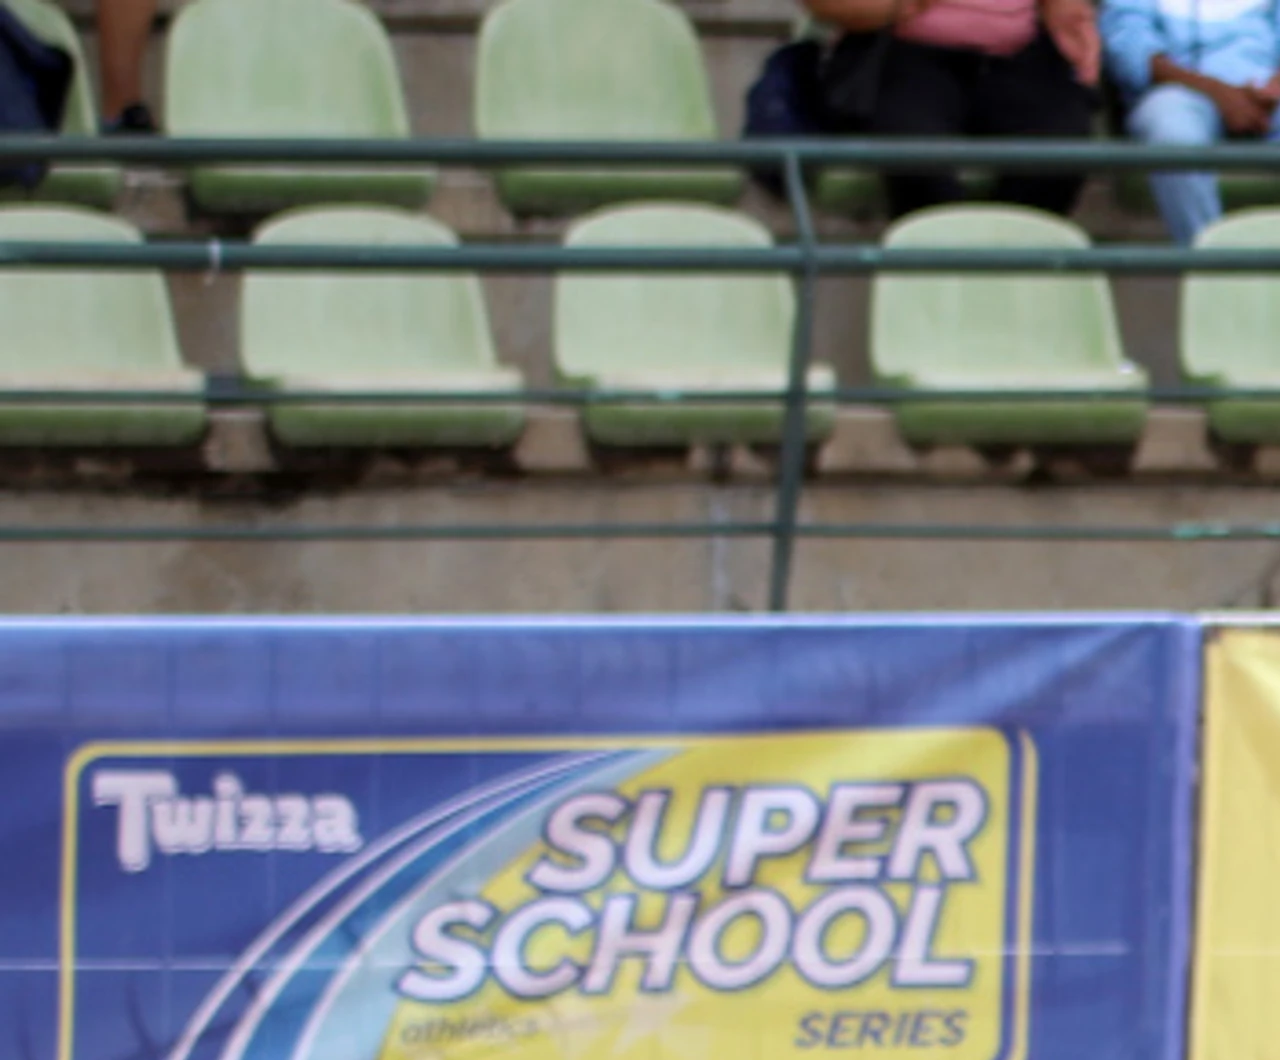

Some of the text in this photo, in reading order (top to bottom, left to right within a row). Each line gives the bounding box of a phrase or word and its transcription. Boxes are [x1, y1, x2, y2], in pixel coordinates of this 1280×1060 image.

[92, 769, 364, 872] Twizza
[525, 777, 988, 894] SUPER
[396, 884, 976, 1002] SCHOOL
[794, 1008, 967, 1050] SERIES
